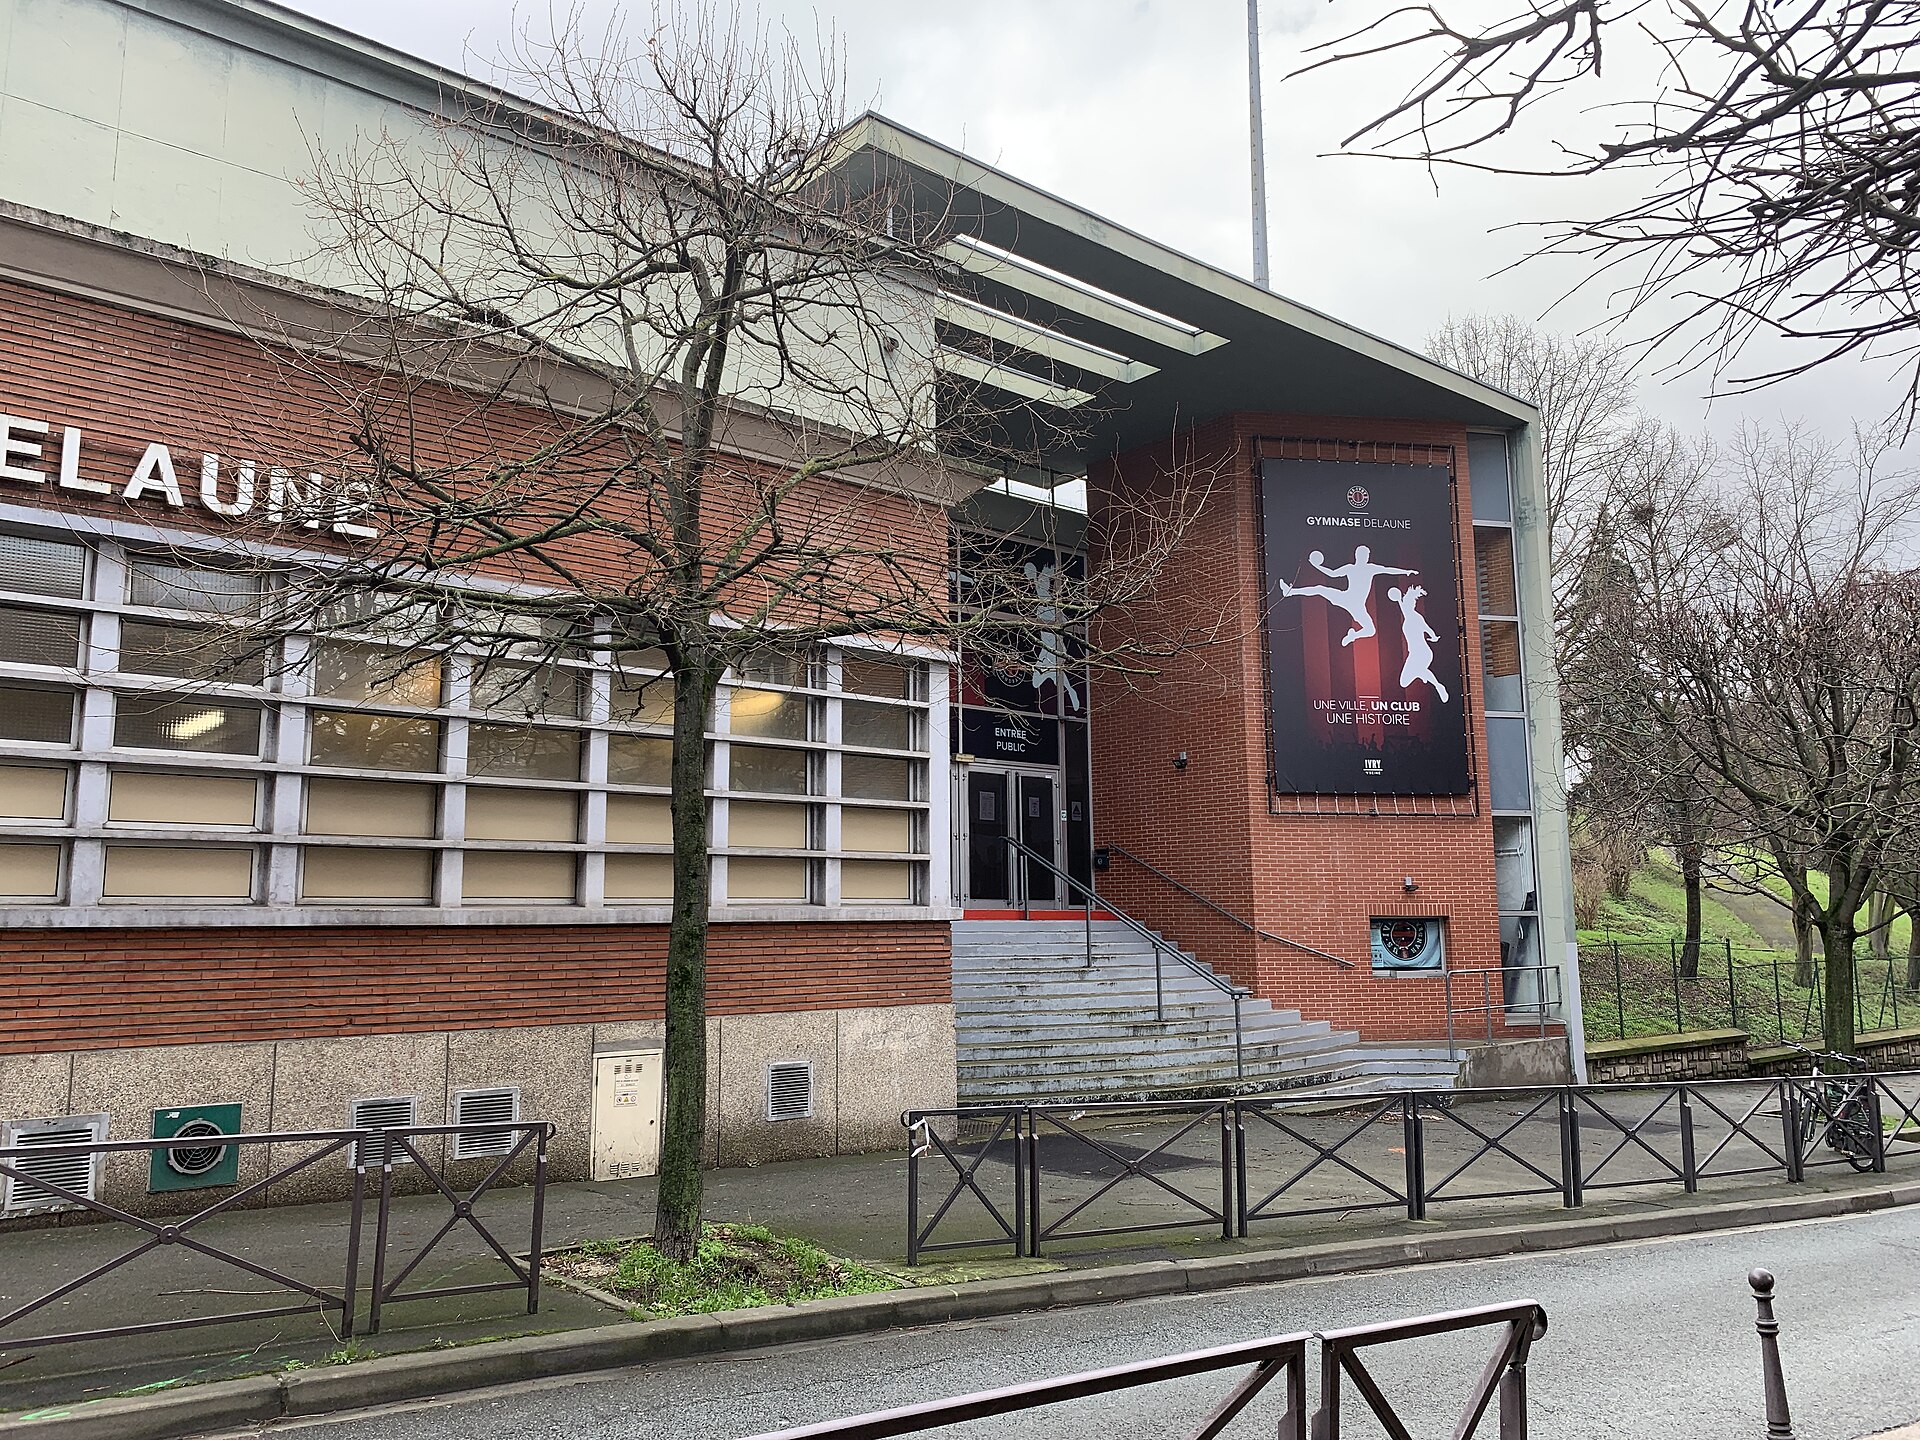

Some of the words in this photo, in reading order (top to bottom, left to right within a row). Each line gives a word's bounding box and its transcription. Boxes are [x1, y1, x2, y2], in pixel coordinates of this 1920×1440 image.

[1306, 516, 1361, 527] GYMNASE
[1363, 518, 1411, 529] DELAUNE
[1313, 699, 1336, 710] UNE
[1338, 700, 1369, 712] VILLE,
[1371, 701, 1388, 711] UN
[1390, 701, 1420, 712] CLUB
[1326, 712, 1352, 725] UNE
[1355, 713, 1410, 726] HISTOIRE
[994, 727, 1027, 739] ENTRÉE
[996, 740, 1026, 753] PUBLIC
[1364, 759, 1381, 769] IVRY
